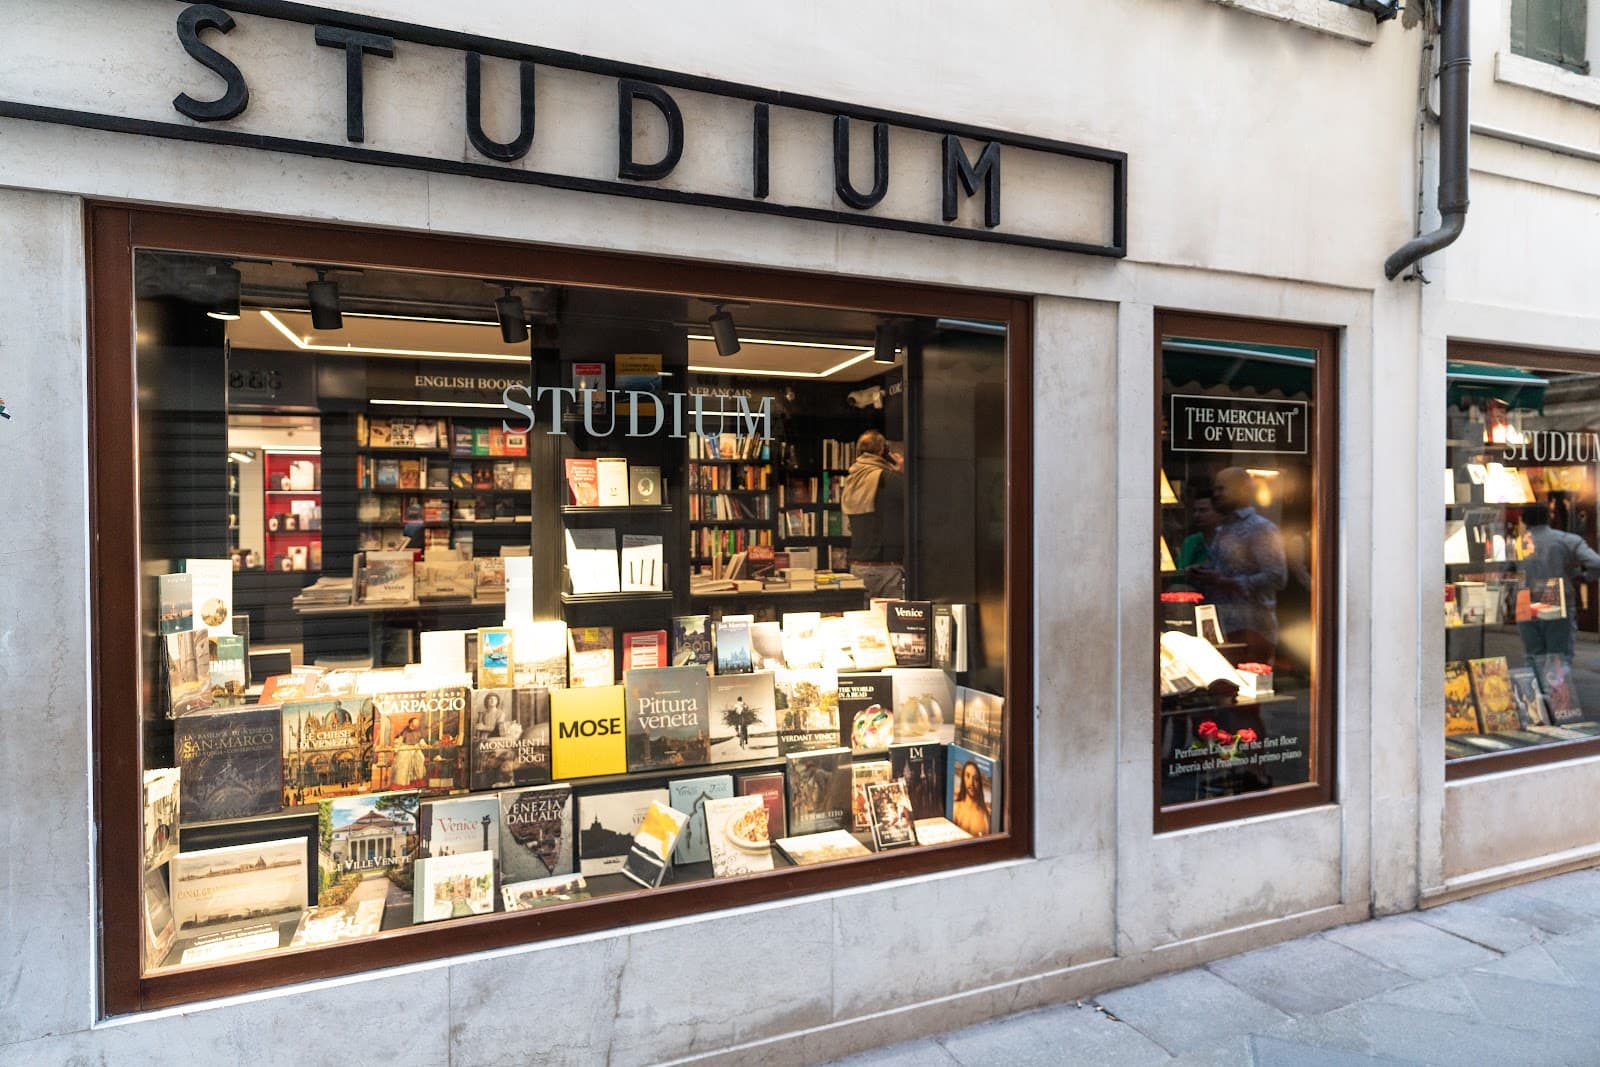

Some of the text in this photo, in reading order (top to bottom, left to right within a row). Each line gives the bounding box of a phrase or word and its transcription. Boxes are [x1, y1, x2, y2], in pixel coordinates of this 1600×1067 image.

[172, 4, 1001, 228] STUDIUM
[414, 374, 474, 390] ENGLISH
[502, 384, 776, 441] STUDIUM
[1184, 407, 1215, 440] THE
[1204, 426, 1276, 443] OF VENICE
[895, 606, 924, 618] Venice
[378, 697, 466, 715] CARPACCIO
[638, 697, 698, 715] Pittura
[559, 717, 622, 739] MOSE
[638, 711, 699, 730] veneta
[220, 733, 275, 749] MARCO
[479, 730, 546, 752] MONUMENTI
[1263, 737, 1279, 748] first
[1279, 735, 1298, 746] floor
[518, 753, 546, 764] DOGI
[1168, 760, 1201, 776] Libreria
[1201, 758, 1215, 771] del
[1249, 753, 1259, 764] al
[1258, 751, 1281, 766] primo
[1281, 749, 1303, 763] piano
[503, 799, 562, 815] VENEZIA
[438, 817, 479, 833] Venice
[344, 858, 374, 872] VILLE
